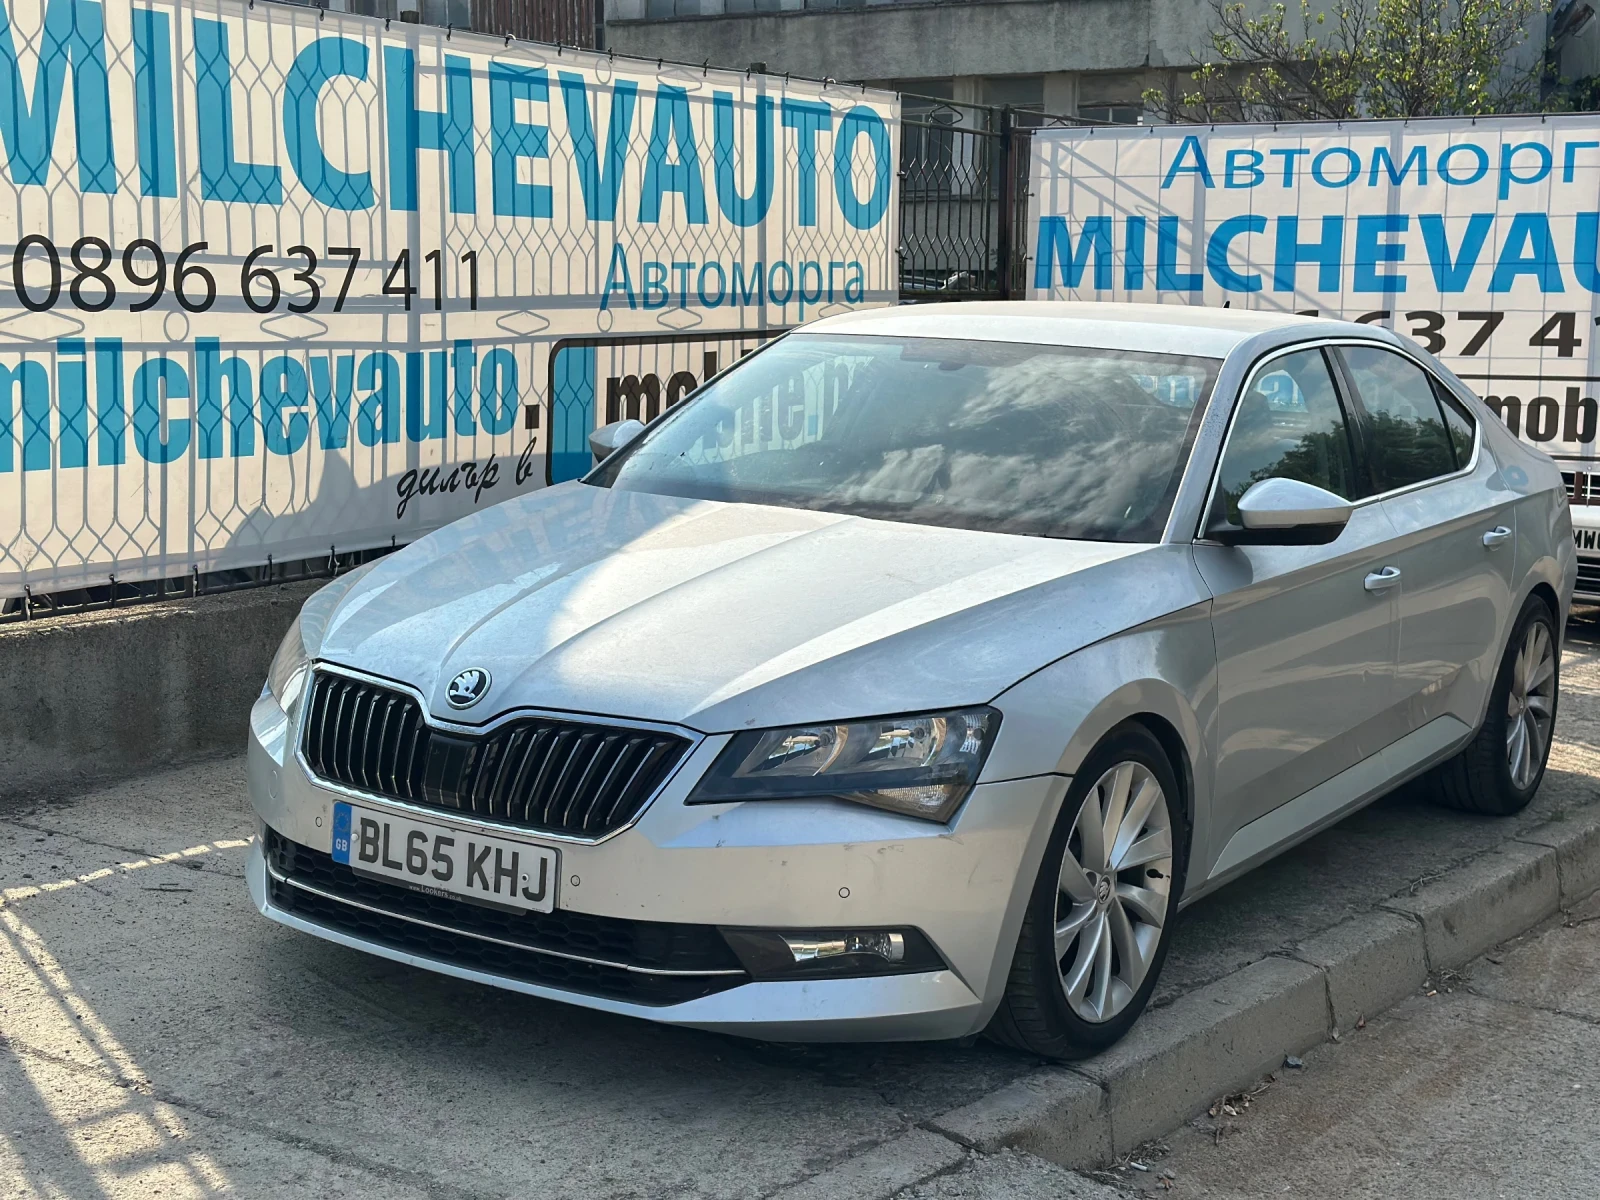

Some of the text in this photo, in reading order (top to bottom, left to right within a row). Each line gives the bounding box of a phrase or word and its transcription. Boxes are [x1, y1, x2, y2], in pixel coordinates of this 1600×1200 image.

[0, 0, 891, 229] MILCHEVAUTO
[12, 235, 477, 313] 0896 637 411
[600, 243, 864, 322] Автоморга
[1354, 310, 1505, 357] 37
[396, 453, 500, 519] дилър
[335, 838, 348, 852] GB
[358, 817, 548, 902] BL65 KHJ
